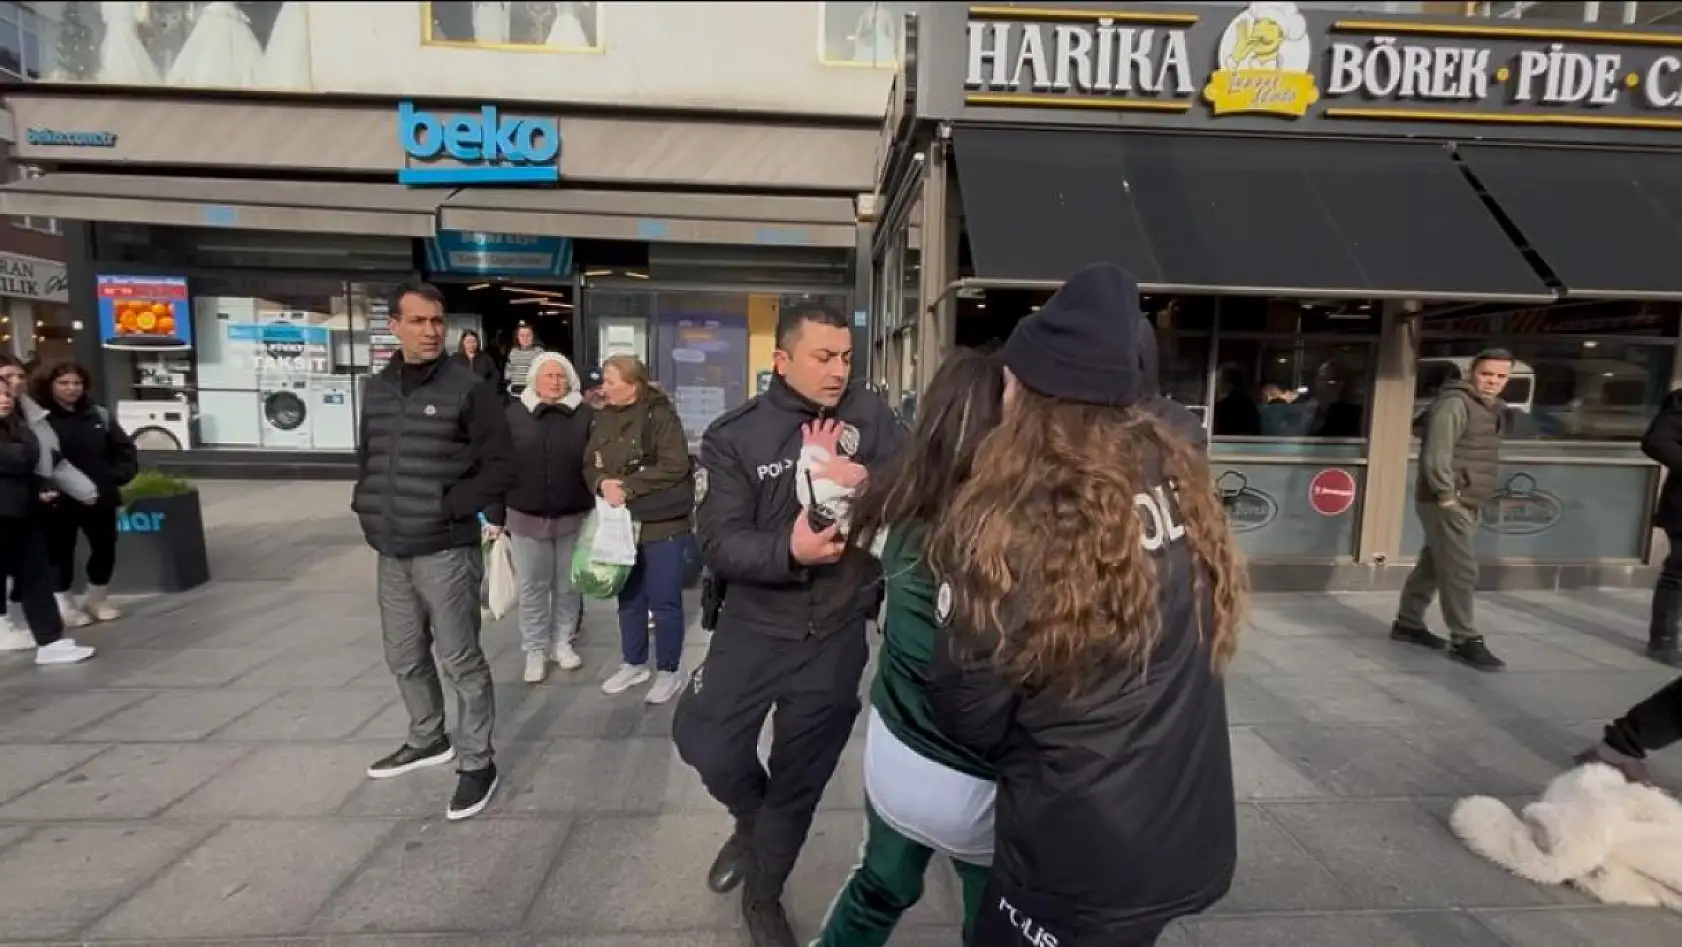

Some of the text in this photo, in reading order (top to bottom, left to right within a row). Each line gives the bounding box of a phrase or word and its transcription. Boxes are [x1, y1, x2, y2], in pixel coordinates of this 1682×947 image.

[965, 18, 1195, 92] HARİKA
[1328, 36, 1682, 107] BÖREK PİDE C
[398, 100, 559, 161] beko
